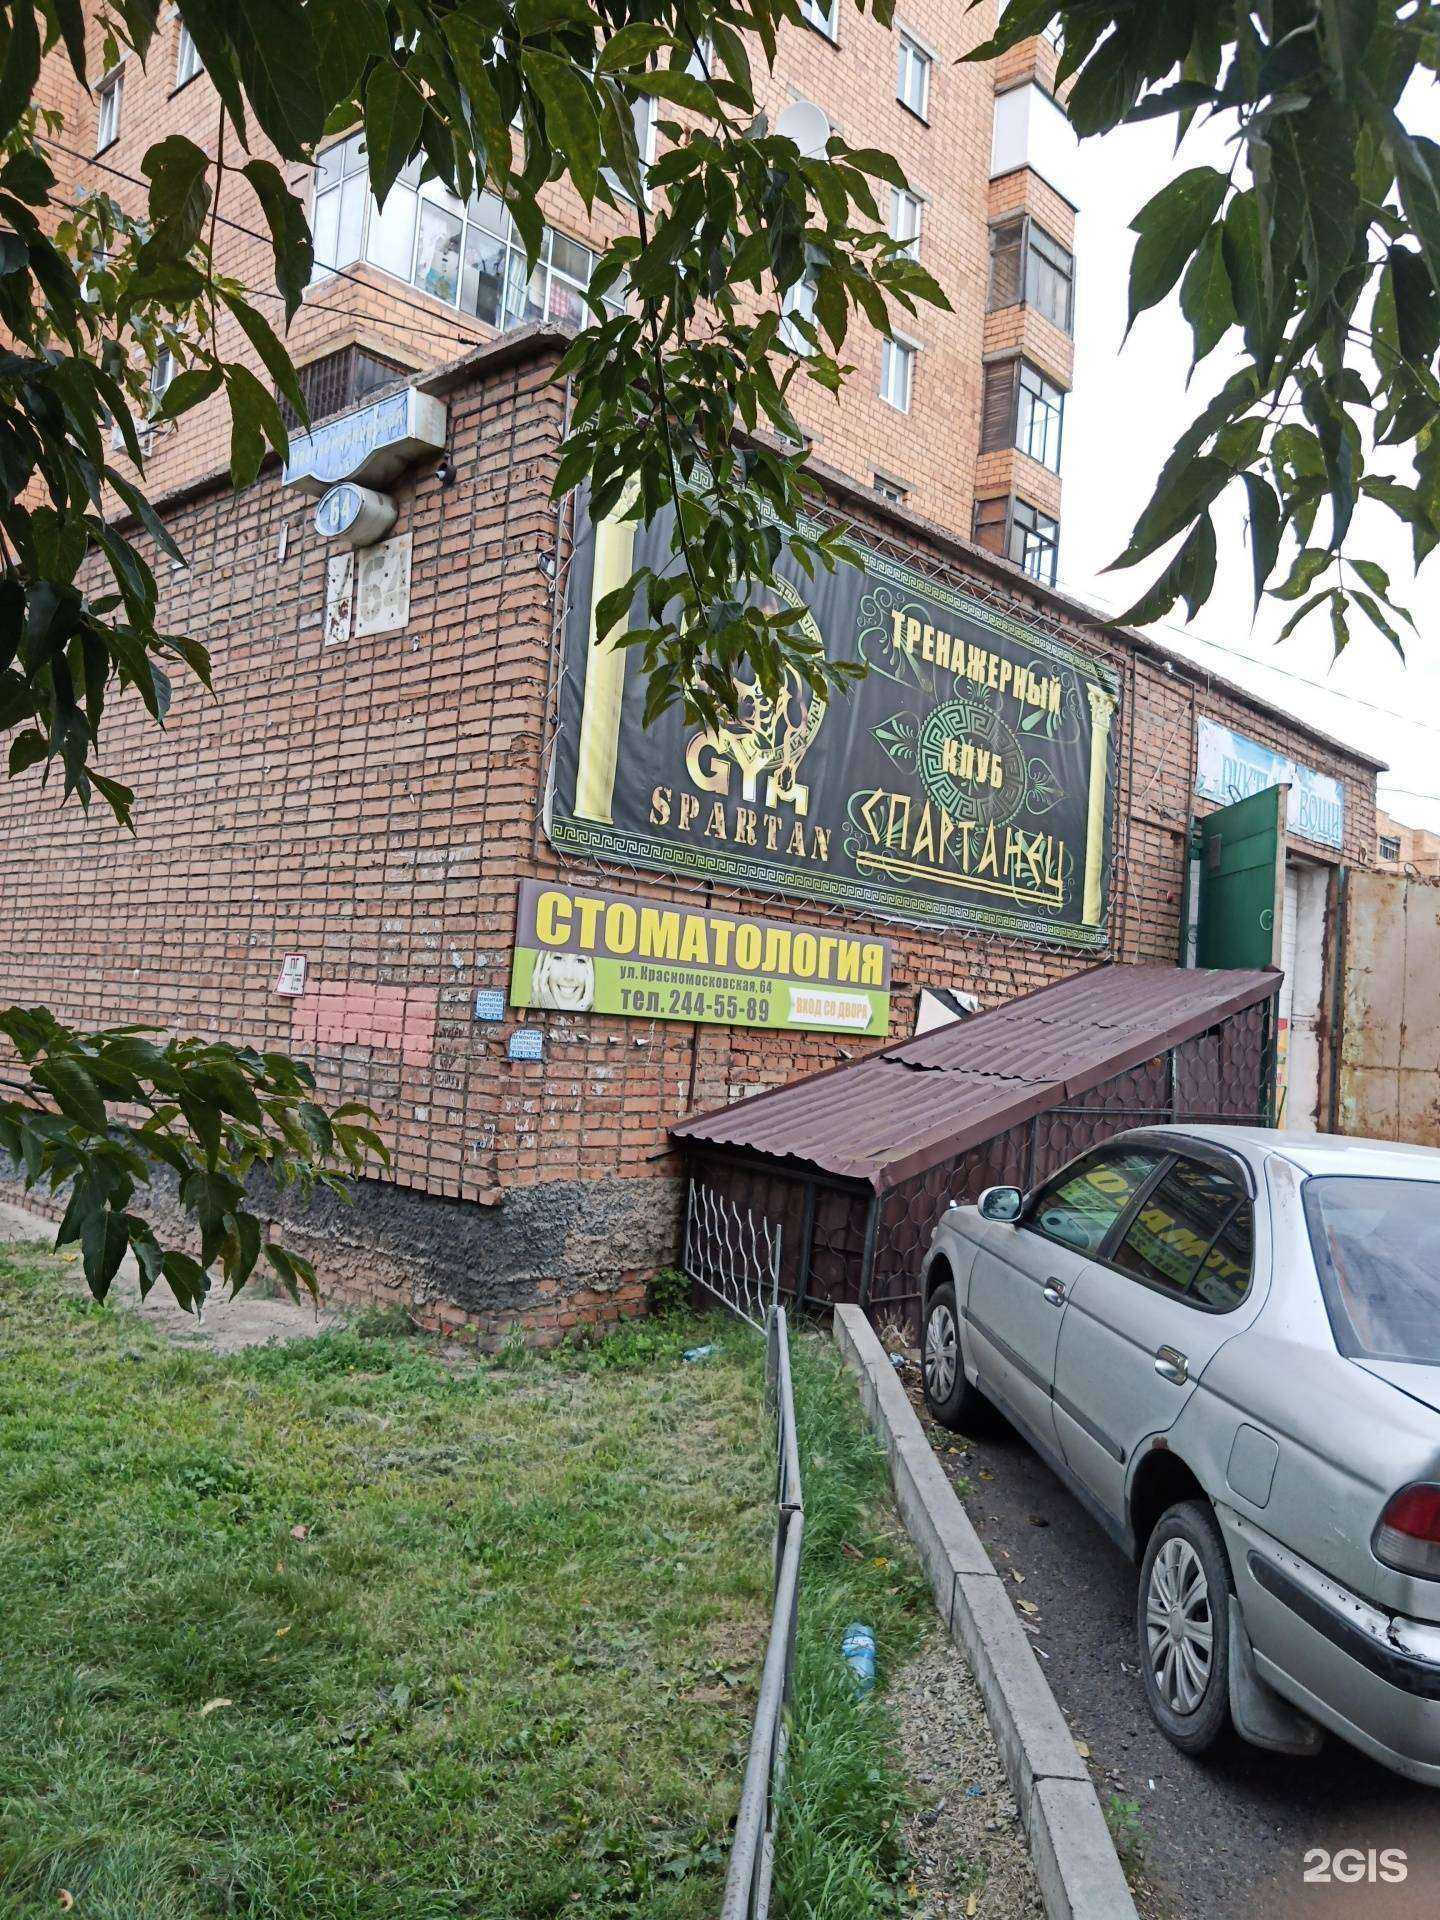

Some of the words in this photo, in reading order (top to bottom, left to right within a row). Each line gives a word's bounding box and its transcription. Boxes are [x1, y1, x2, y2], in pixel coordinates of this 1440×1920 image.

[891, 609, 1062, 716] ТРЕНАЖЕРНЫЙ
[685, 726, 810, 817] GYM
[942, 737, 1004, 789] КЛУБ
[649, 785, 832, 862] SPARTAN
[860, 787, 1064, 899] СПАРТАНЕЦ
[535, 890, 884, 986] СТОМАТОЛОГИЯ
[620, 988, 665, 1013] тел.
[669, 989, 770, 1023] 244-55-89
[759, 980, 772, 995] 64
[796, 996, 822, 1017] ВХОД
[824, 999, 836, 1017] СО
[838, 1001, 868, 1020] ДВОРА
